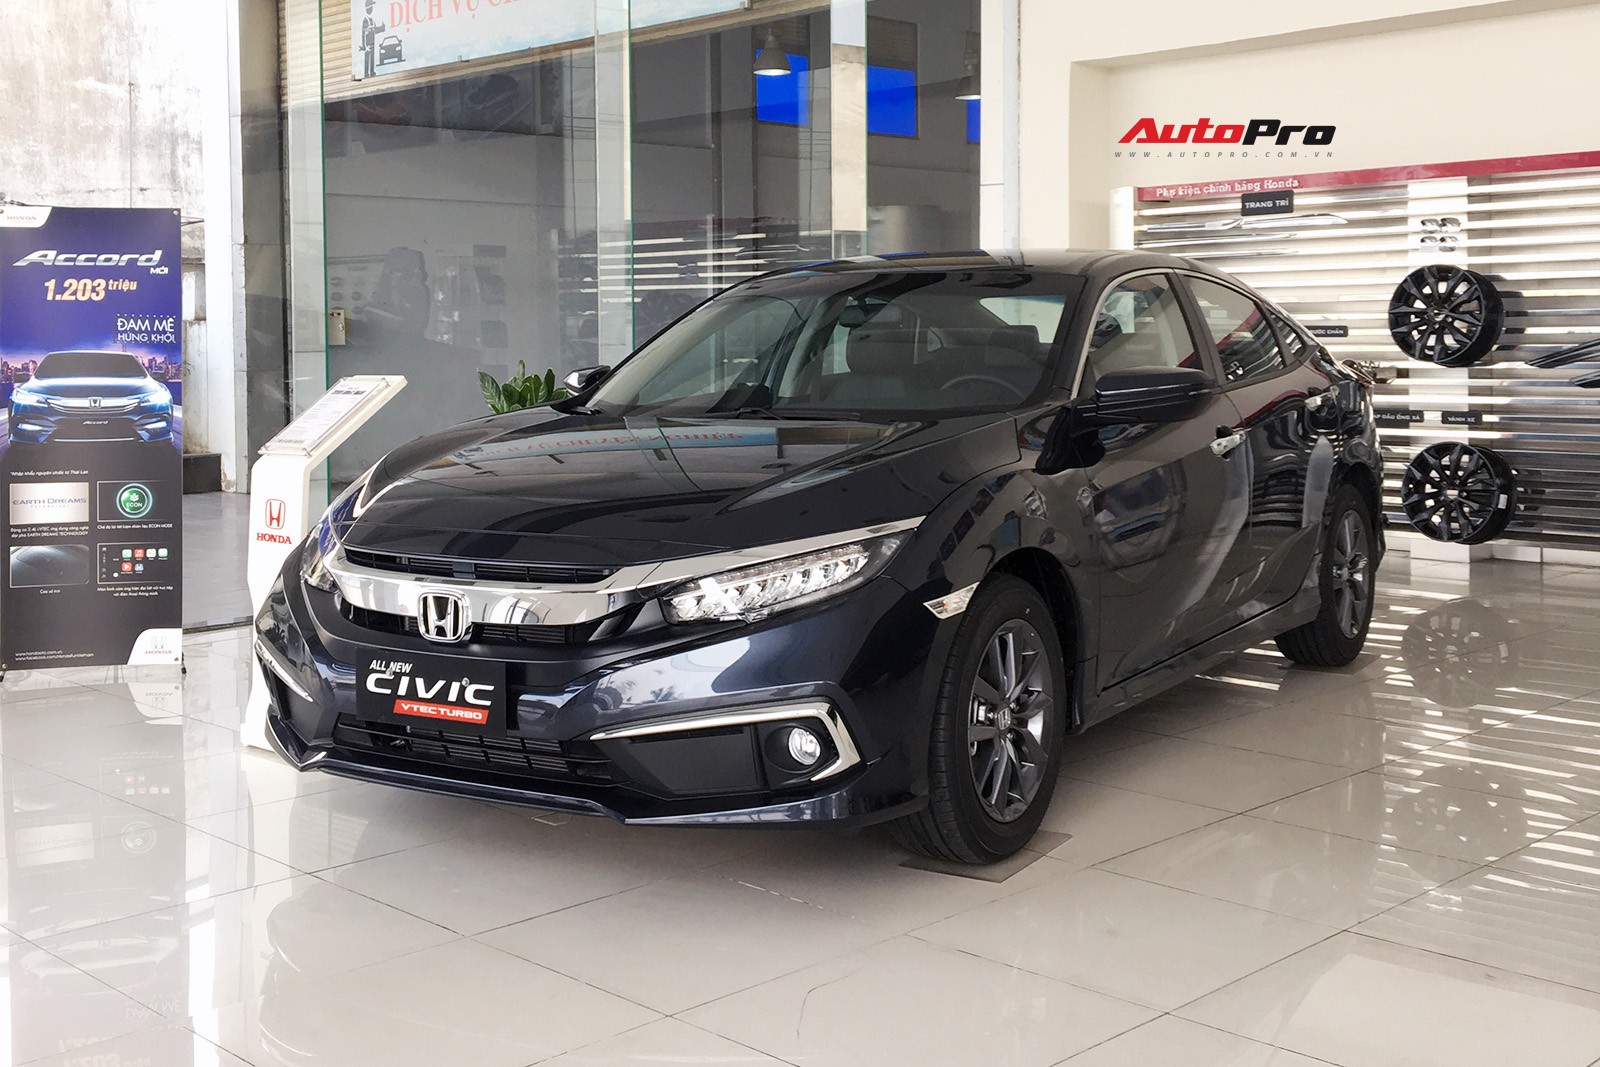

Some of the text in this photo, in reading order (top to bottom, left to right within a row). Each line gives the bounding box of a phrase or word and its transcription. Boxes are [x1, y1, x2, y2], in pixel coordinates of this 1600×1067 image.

[1264, 178, 1299, 189] Honda
[1245, 198, 1289, 209] TRANG TRÍ
[12, 250, 163, 266] Accord
[44, 278, 138, 301] 1.203 triệu
[117, 318, 175, 332] ĐAM MÊ
[256, 533, 292, 544] HONDA
[370, 660, 412, 673] ALL NEW
[366, 673, 494, 706] CIVIC
